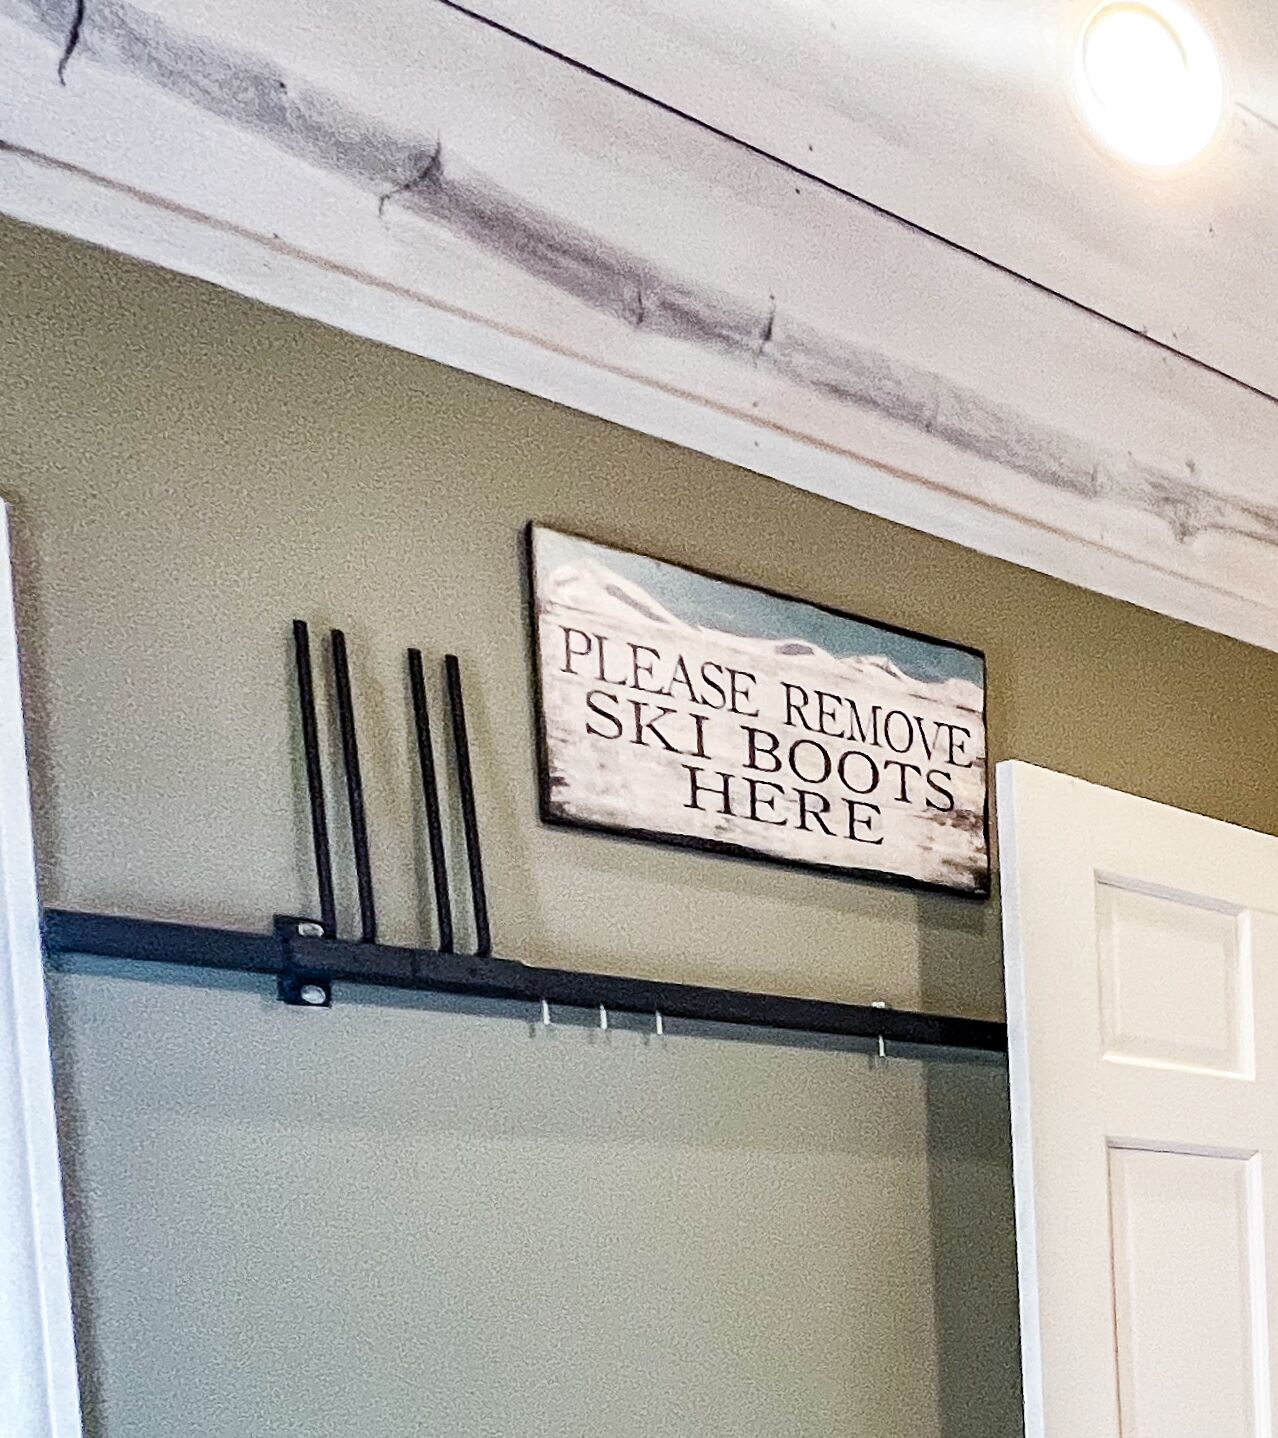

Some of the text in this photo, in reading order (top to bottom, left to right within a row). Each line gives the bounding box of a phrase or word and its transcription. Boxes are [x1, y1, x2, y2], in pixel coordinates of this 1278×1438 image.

[559, 625, 974, 768] PLEASE REMOVE
[585, 690, 955, 812] SKI BOOTS
[682, 764, 884, 845] HERE
